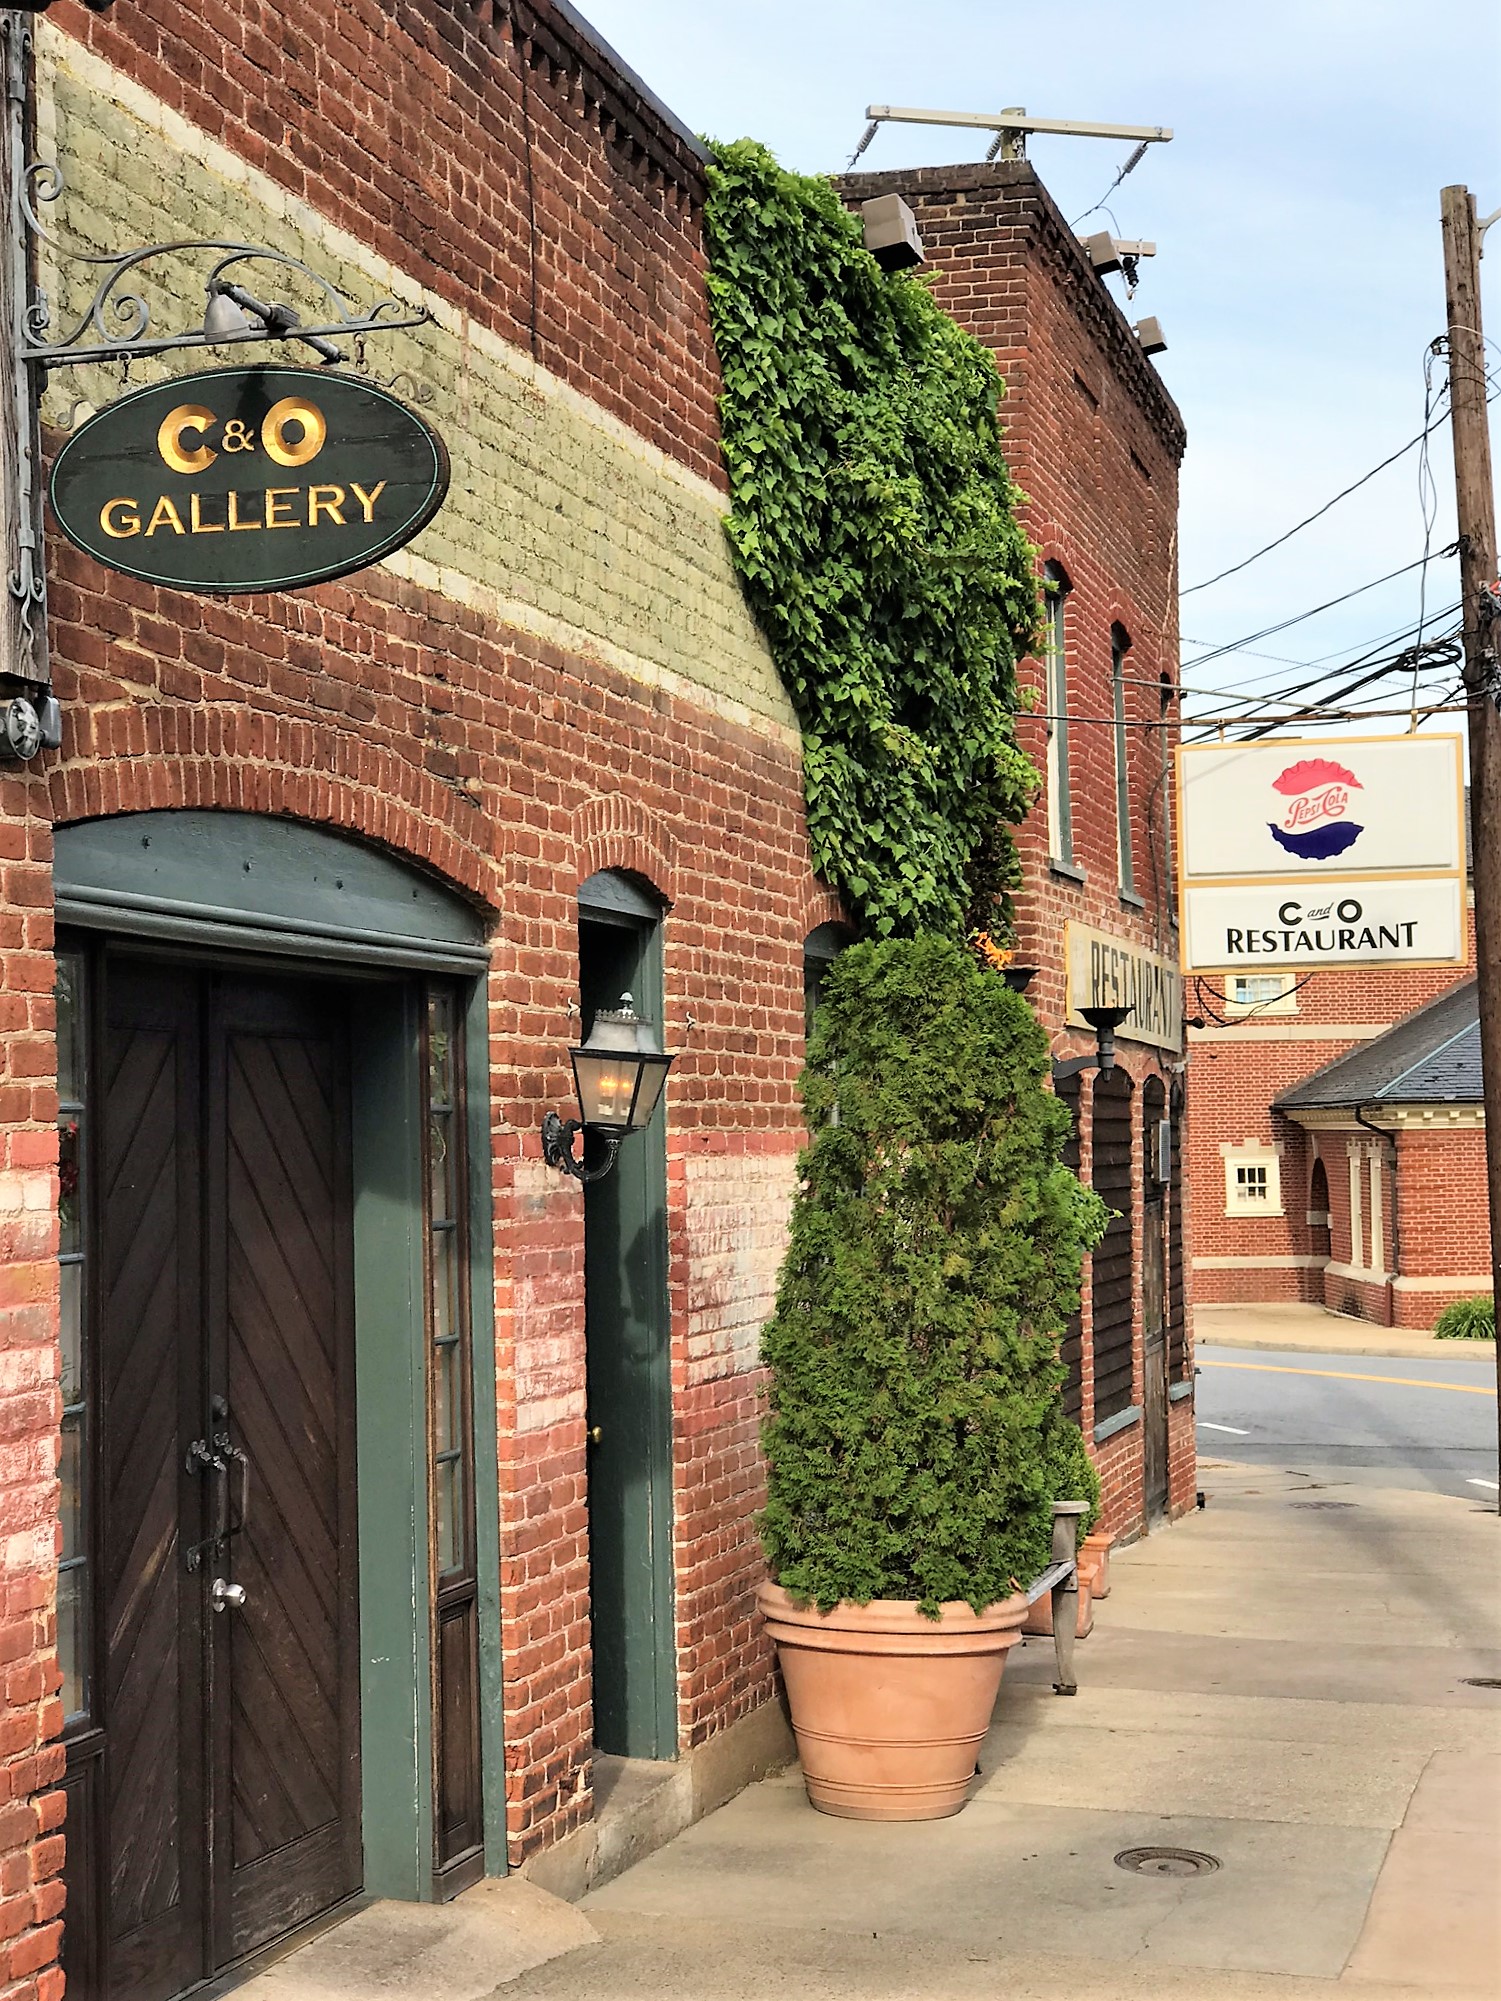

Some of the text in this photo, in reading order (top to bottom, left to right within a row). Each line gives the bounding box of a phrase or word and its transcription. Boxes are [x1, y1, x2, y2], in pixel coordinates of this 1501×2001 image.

[100, 480, 388, 538] GALLERY
[1278, 899, 1363, 926] C and O
[1227, 921, 1418, 953] RESTAURANT
